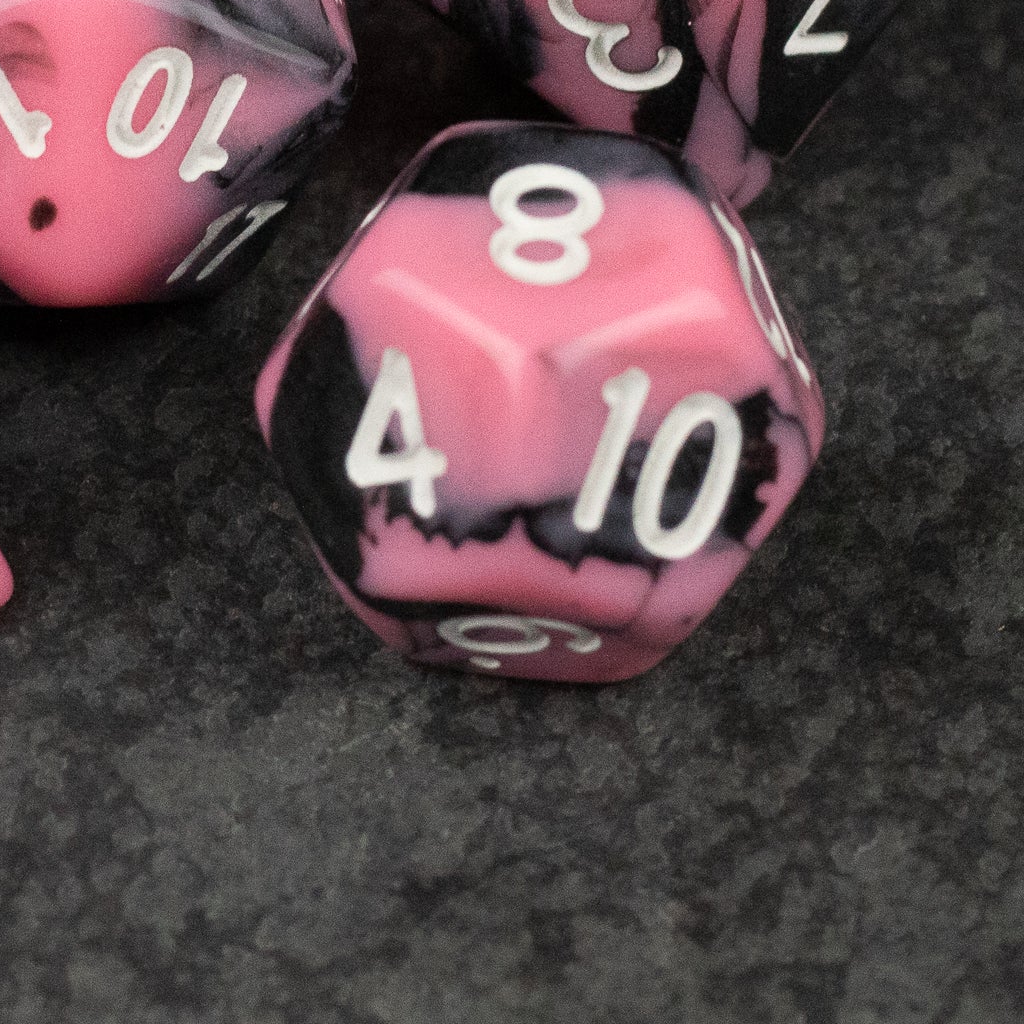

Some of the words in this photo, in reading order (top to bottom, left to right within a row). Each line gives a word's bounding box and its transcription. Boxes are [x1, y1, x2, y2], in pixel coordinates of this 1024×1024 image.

[105, 45, 249, 184] 10
[486, 161, 613, 287] 8
[344, 346, 450, 521] 4
[570, 366, 744, 562] 10
